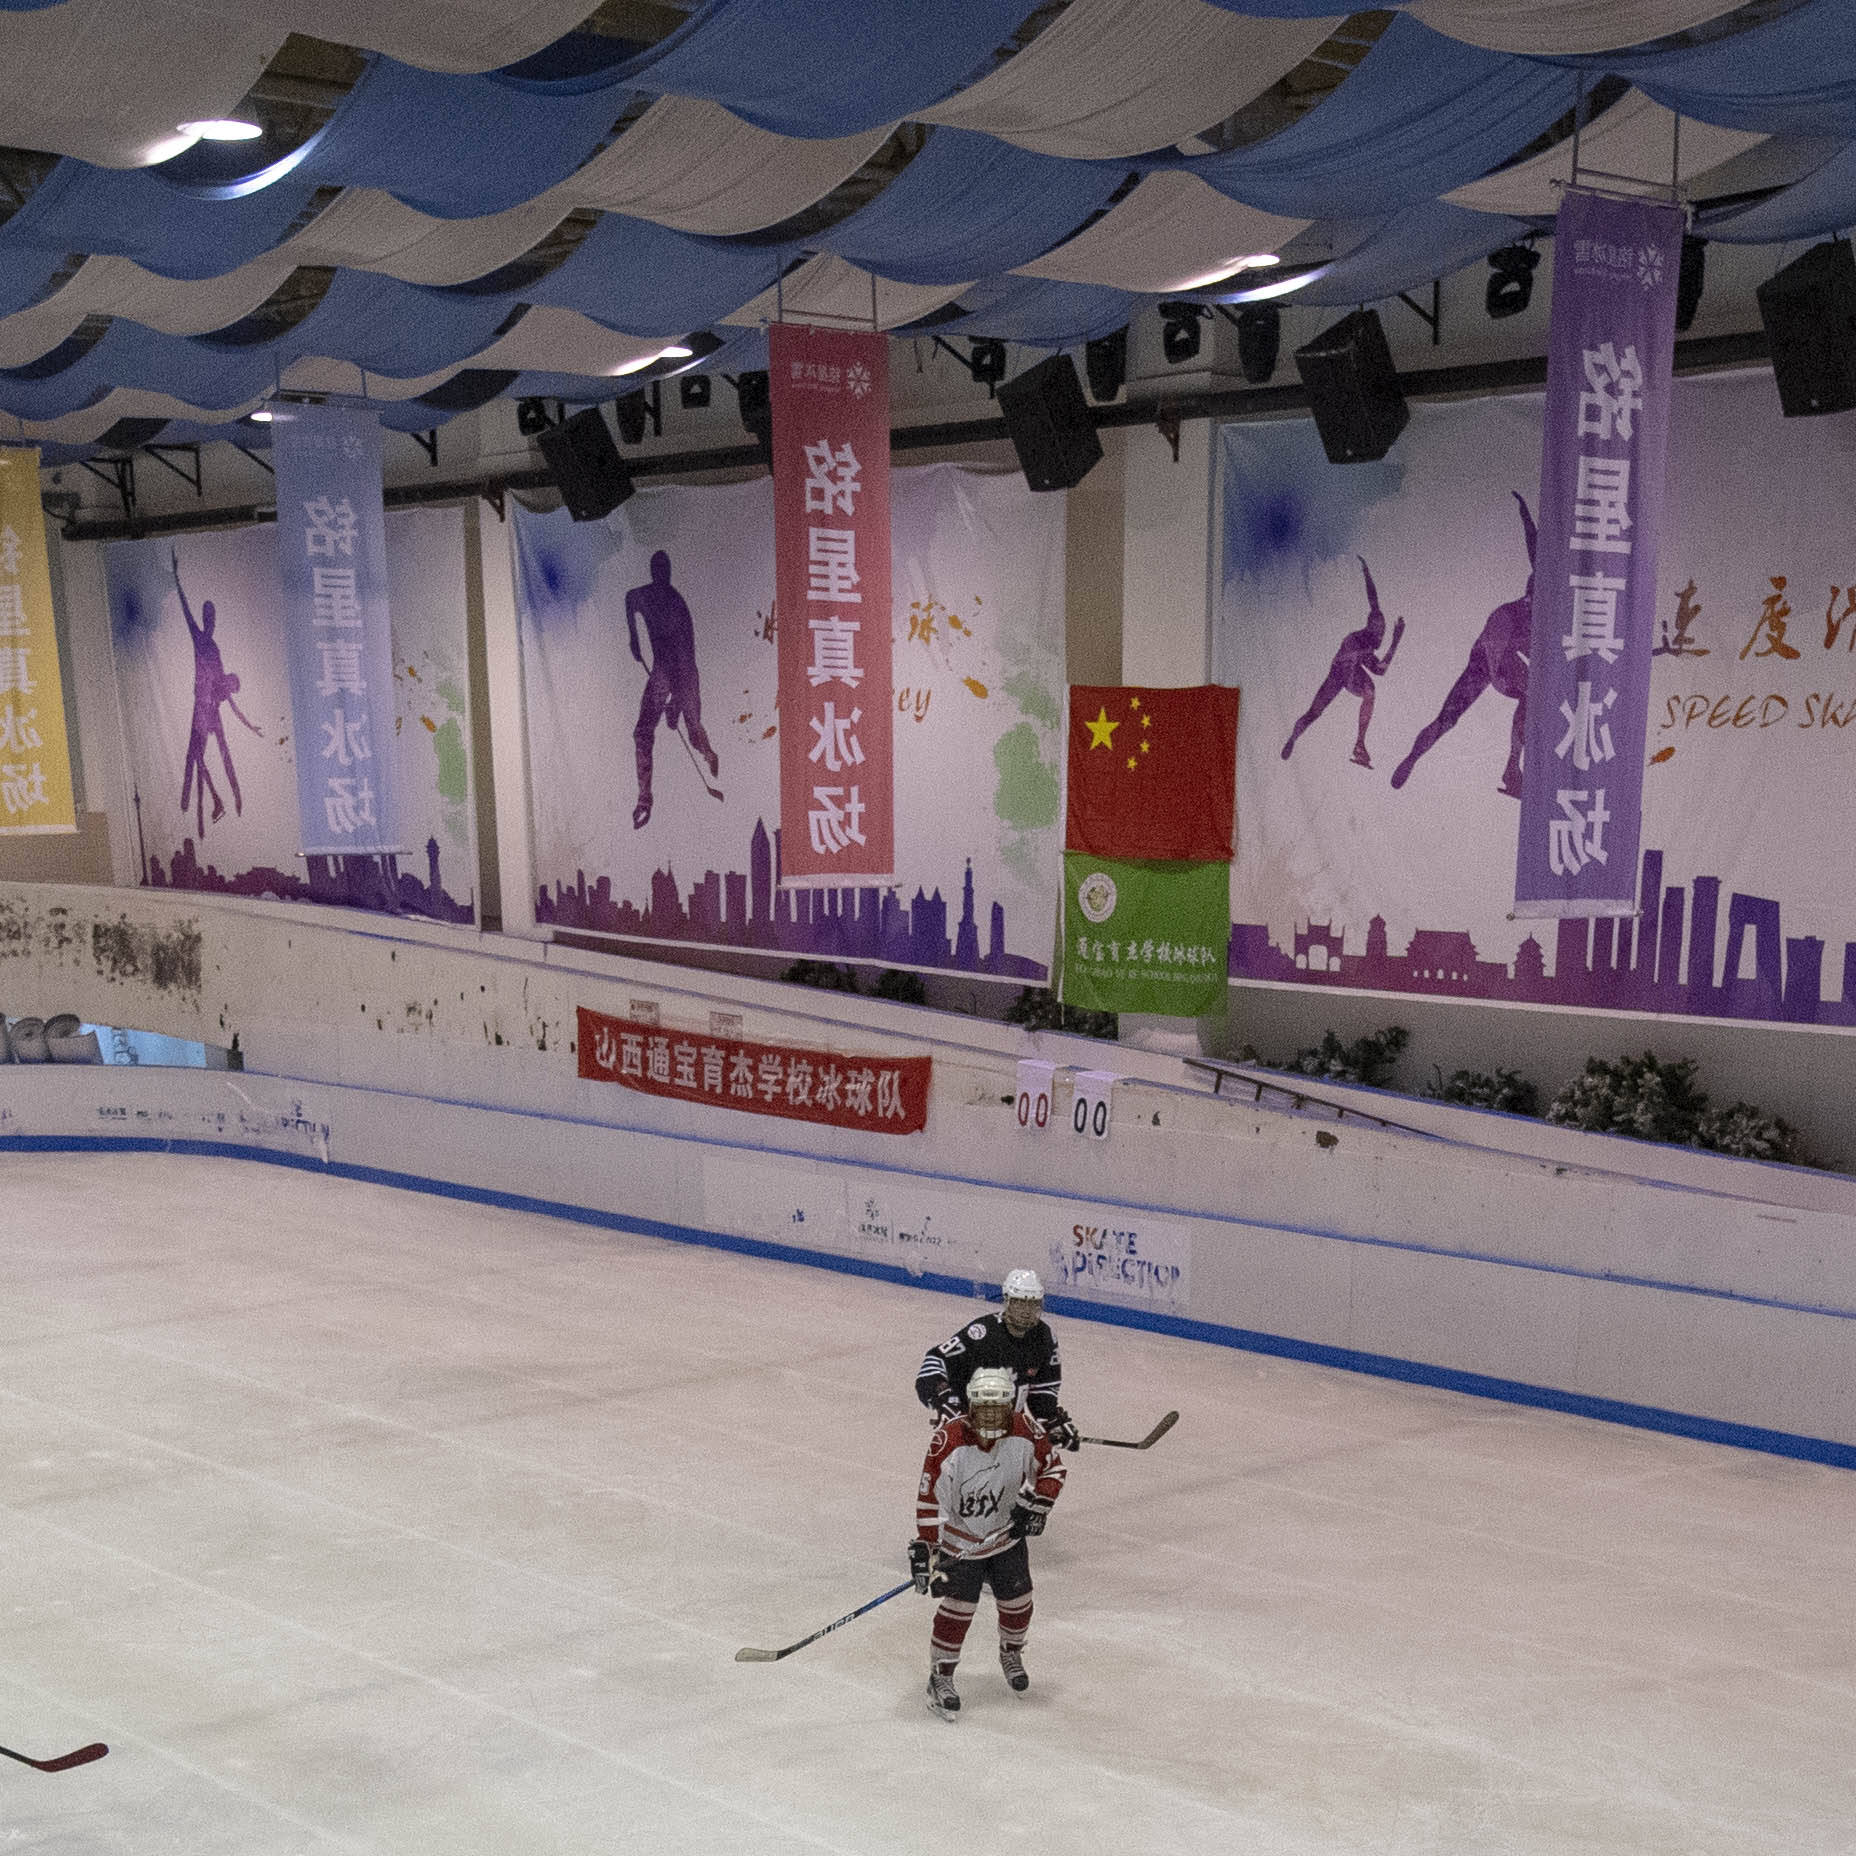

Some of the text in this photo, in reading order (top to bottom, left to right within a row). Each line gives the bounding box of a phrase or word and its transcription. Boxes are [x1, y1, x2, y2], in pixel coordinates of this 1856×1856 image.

[1660, 693, 1790, 730] SPEED
[594, 1027, 906, 1121] 山西通宝育杰学校冰球队
[1017, 1090, 1049, 1128] 00
[1073, 1096, 1108, 1138] 00
